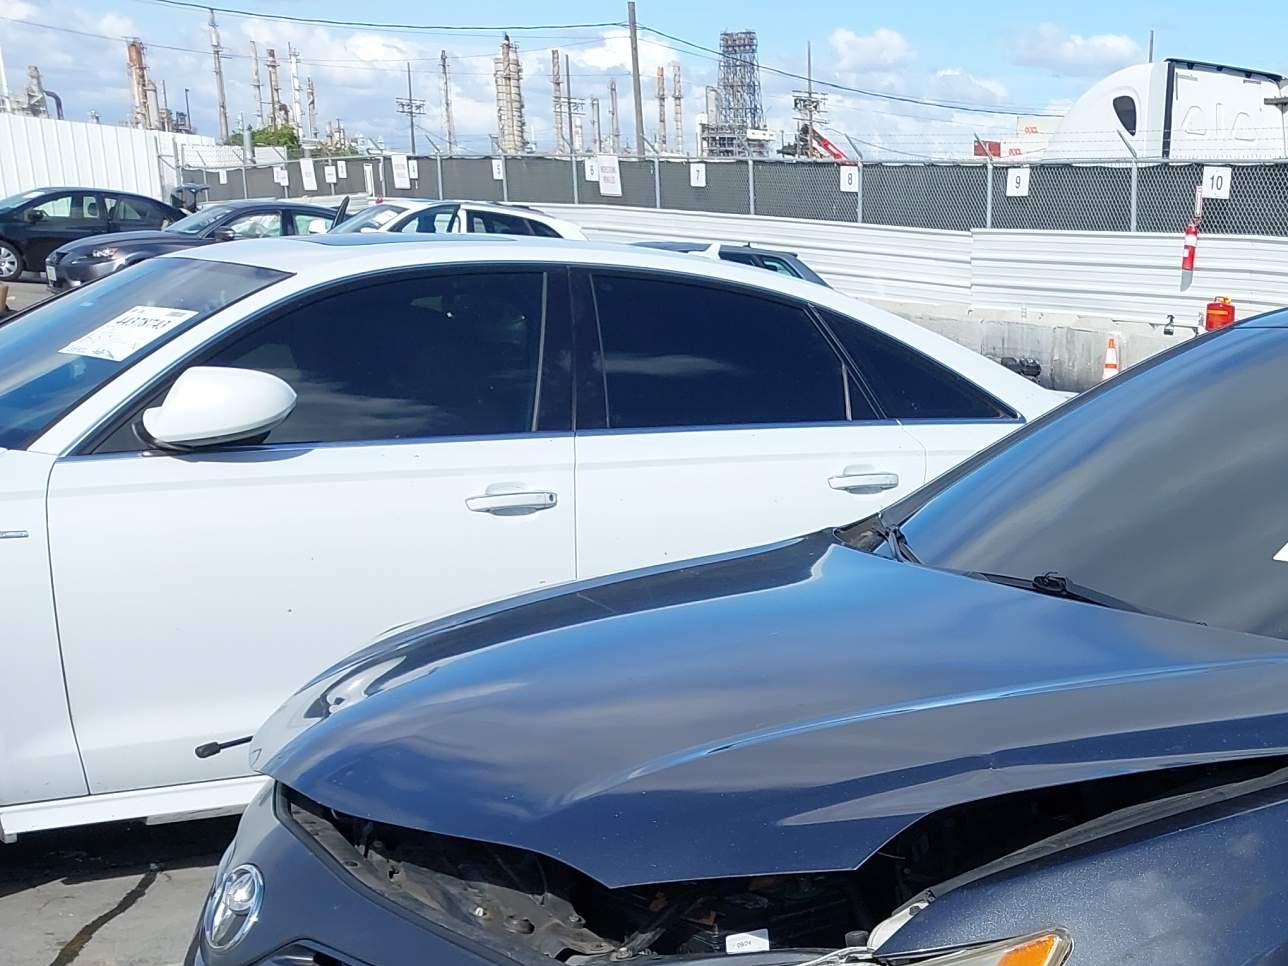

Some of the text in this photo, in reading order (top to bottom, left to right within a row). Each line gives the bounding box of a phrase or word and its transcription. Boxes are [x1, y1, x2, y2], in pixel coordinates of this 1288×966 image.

[847, 172, 853, 186] 8
[1015, 175, 1021, 189] 9
[1210, 176, 1223, 191] 10
